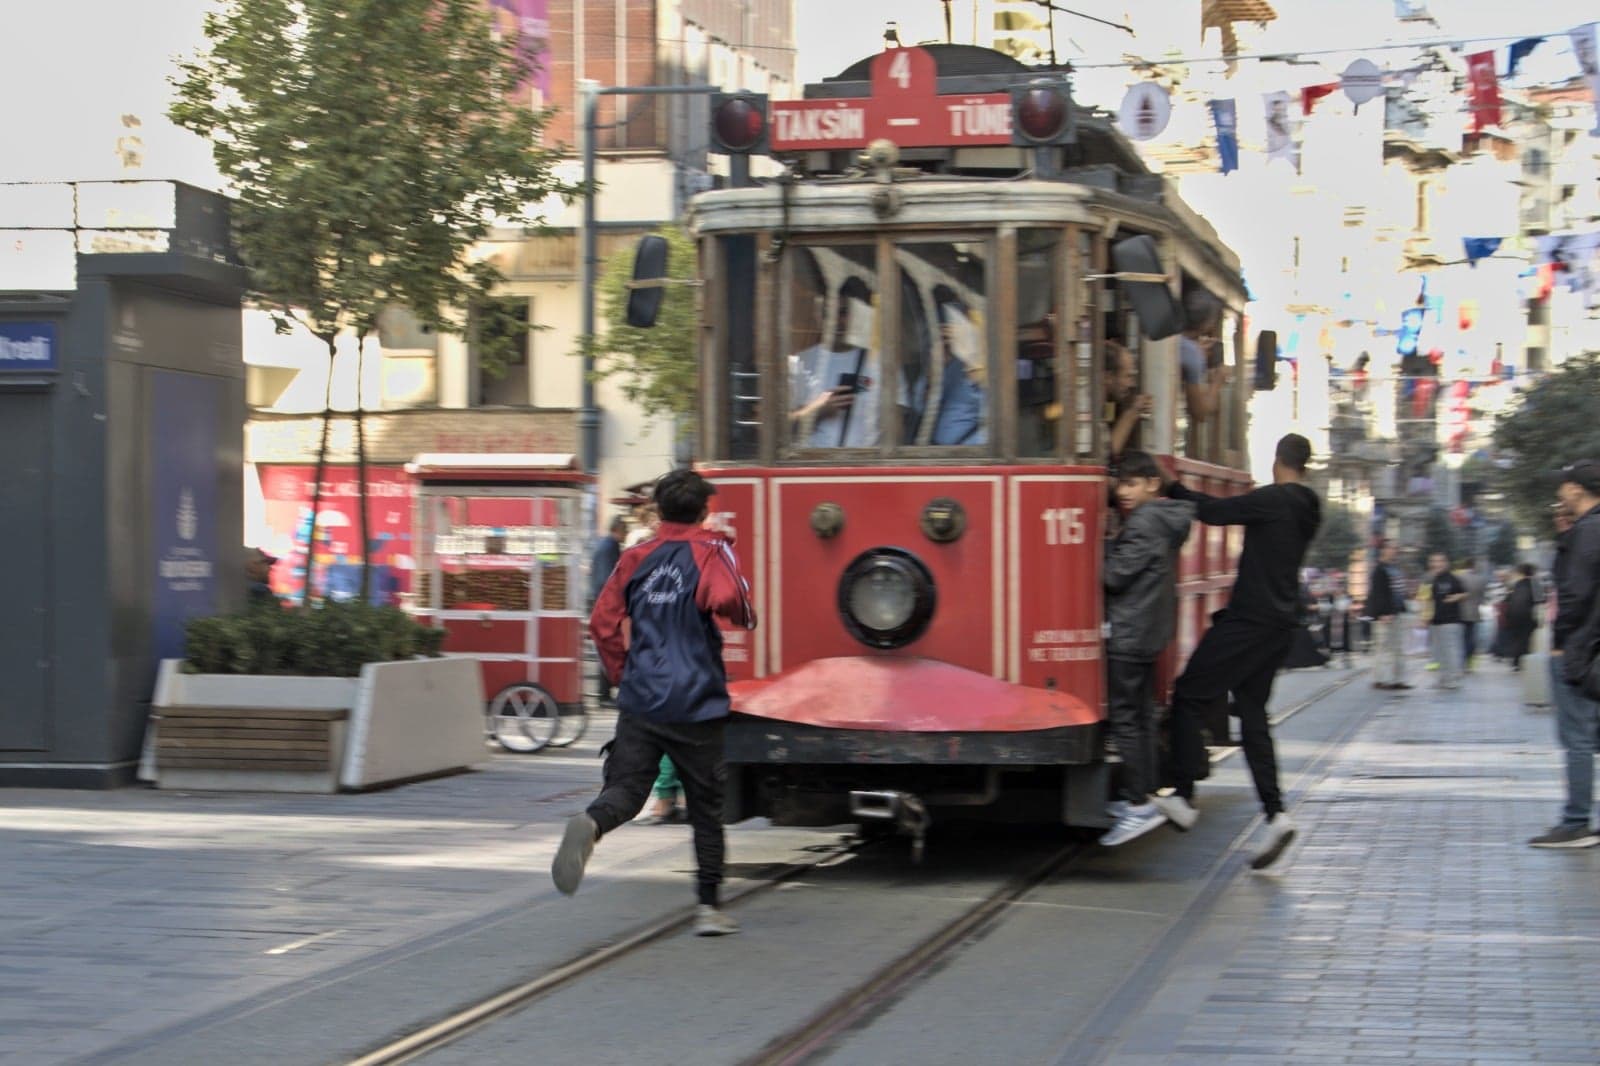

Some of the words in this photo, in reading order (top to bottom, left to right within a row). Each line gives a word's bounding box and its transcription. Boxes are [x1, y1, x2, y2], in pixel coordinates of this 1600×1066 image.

[887, 52, 912, 89] 4
[774, 102, 865, 141] TAKSİM
[946, 98, 1014, 136] TÜNE
[1040, 507, 1085, 545] 115
